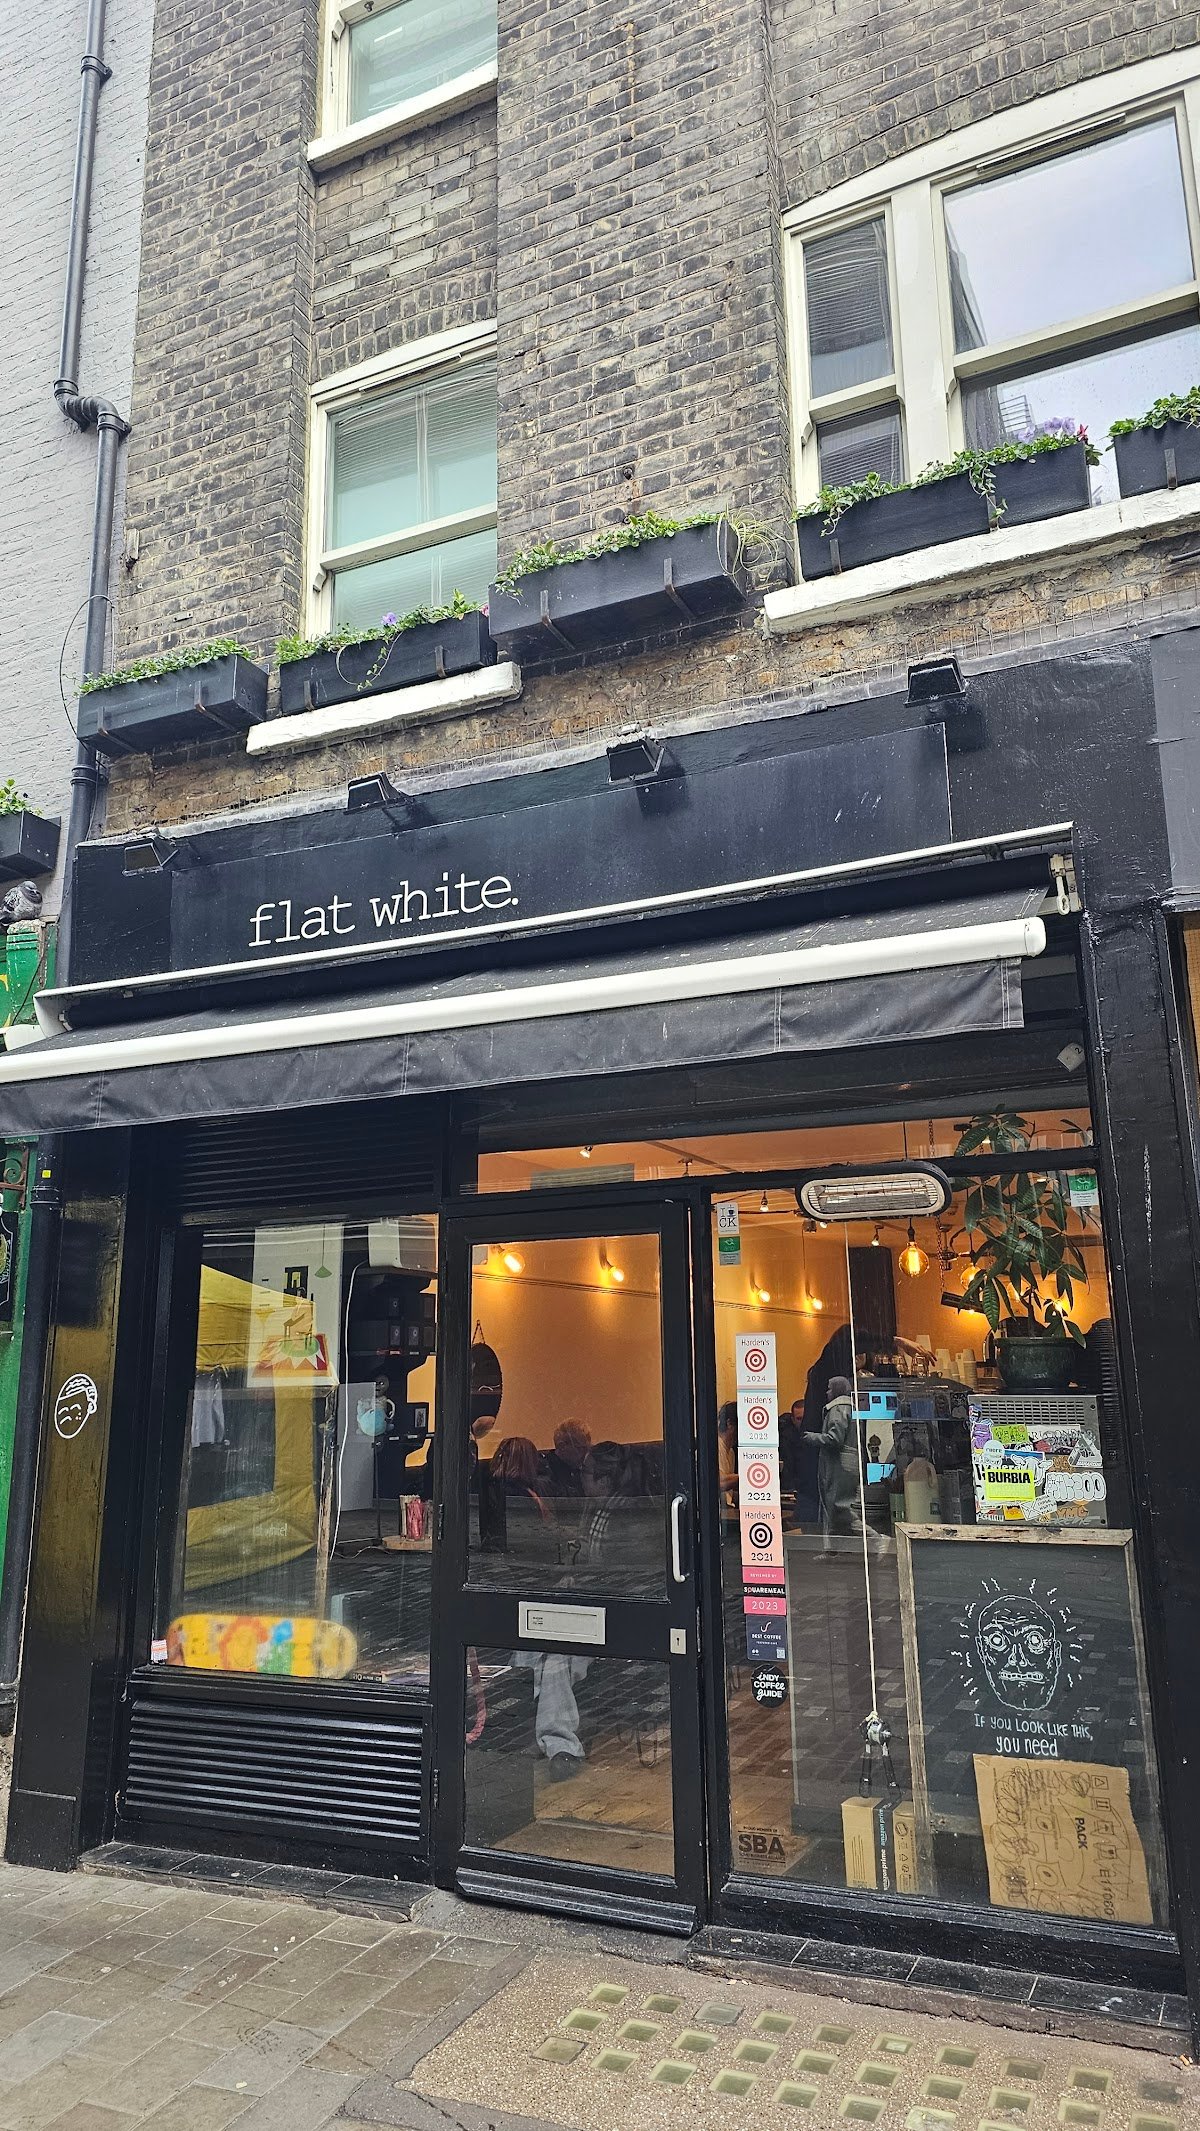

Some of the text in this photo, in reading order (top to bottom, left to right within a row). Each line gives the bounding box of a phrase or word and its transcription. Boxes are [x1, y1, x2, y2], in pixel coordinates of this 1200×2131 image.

[248, 871, 519, 947] flat white.
[719, 1217, 737, 1228] CK
[741, 1338, 770, 1347] Harden's
[746, 1375, 766, 1383] 2024
[743, 1396, 772, 1404] Harden's
[749, 1432, 768, 1440] 2023
[743, 1450, 774, 1460] Harden's
[988, 1471, 1031, 1484] BURBIA
[747, 1492, 772, 1501] 2022
[745, 1511, 776, 1520] Harden's
[751, 1552, 773, 1562] 2021
[743, 1586, 785, 1595] SQUAREMEAL
[751, 1600, 778, 1611] 2023
[973, 1713, 986, 1728] IF
[1015, 1718, 1047, 1735] LOOK
[1047, 1722, 1069, 1737] LIKE
[1024, 1738, 1058, 1757] need
[1074, 1817, 1088, 1850] PACK
[738, 1833, 786, 1856] SBA
